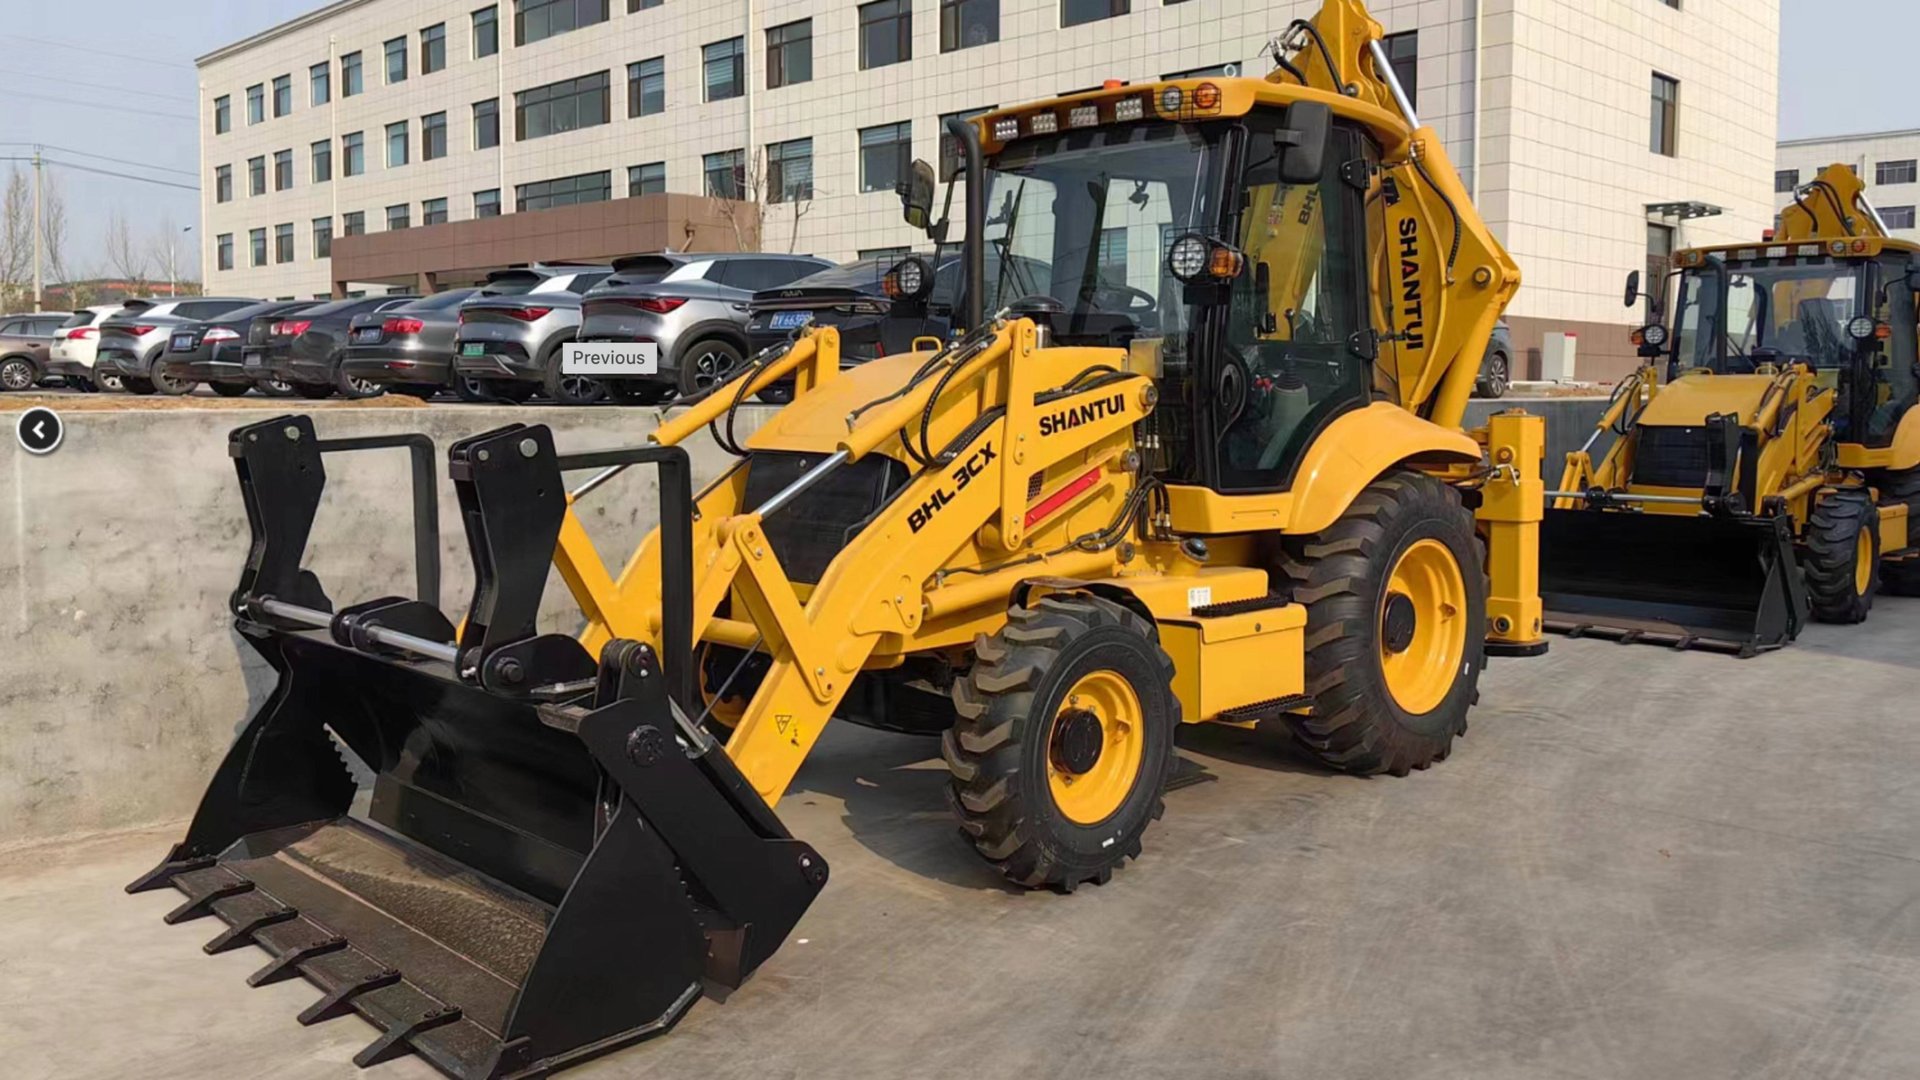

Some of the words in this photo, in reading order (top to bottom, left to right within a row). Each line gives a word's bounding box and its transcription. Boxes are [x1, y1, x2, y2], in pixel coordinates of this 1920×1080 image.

[1399, 217, 1423, 350] SHANTUI
[1039, 393, 1125, 437] SHANTUI
[907, 485, 955, 534] BHL
[952, 441, 997, 491] 3CX
